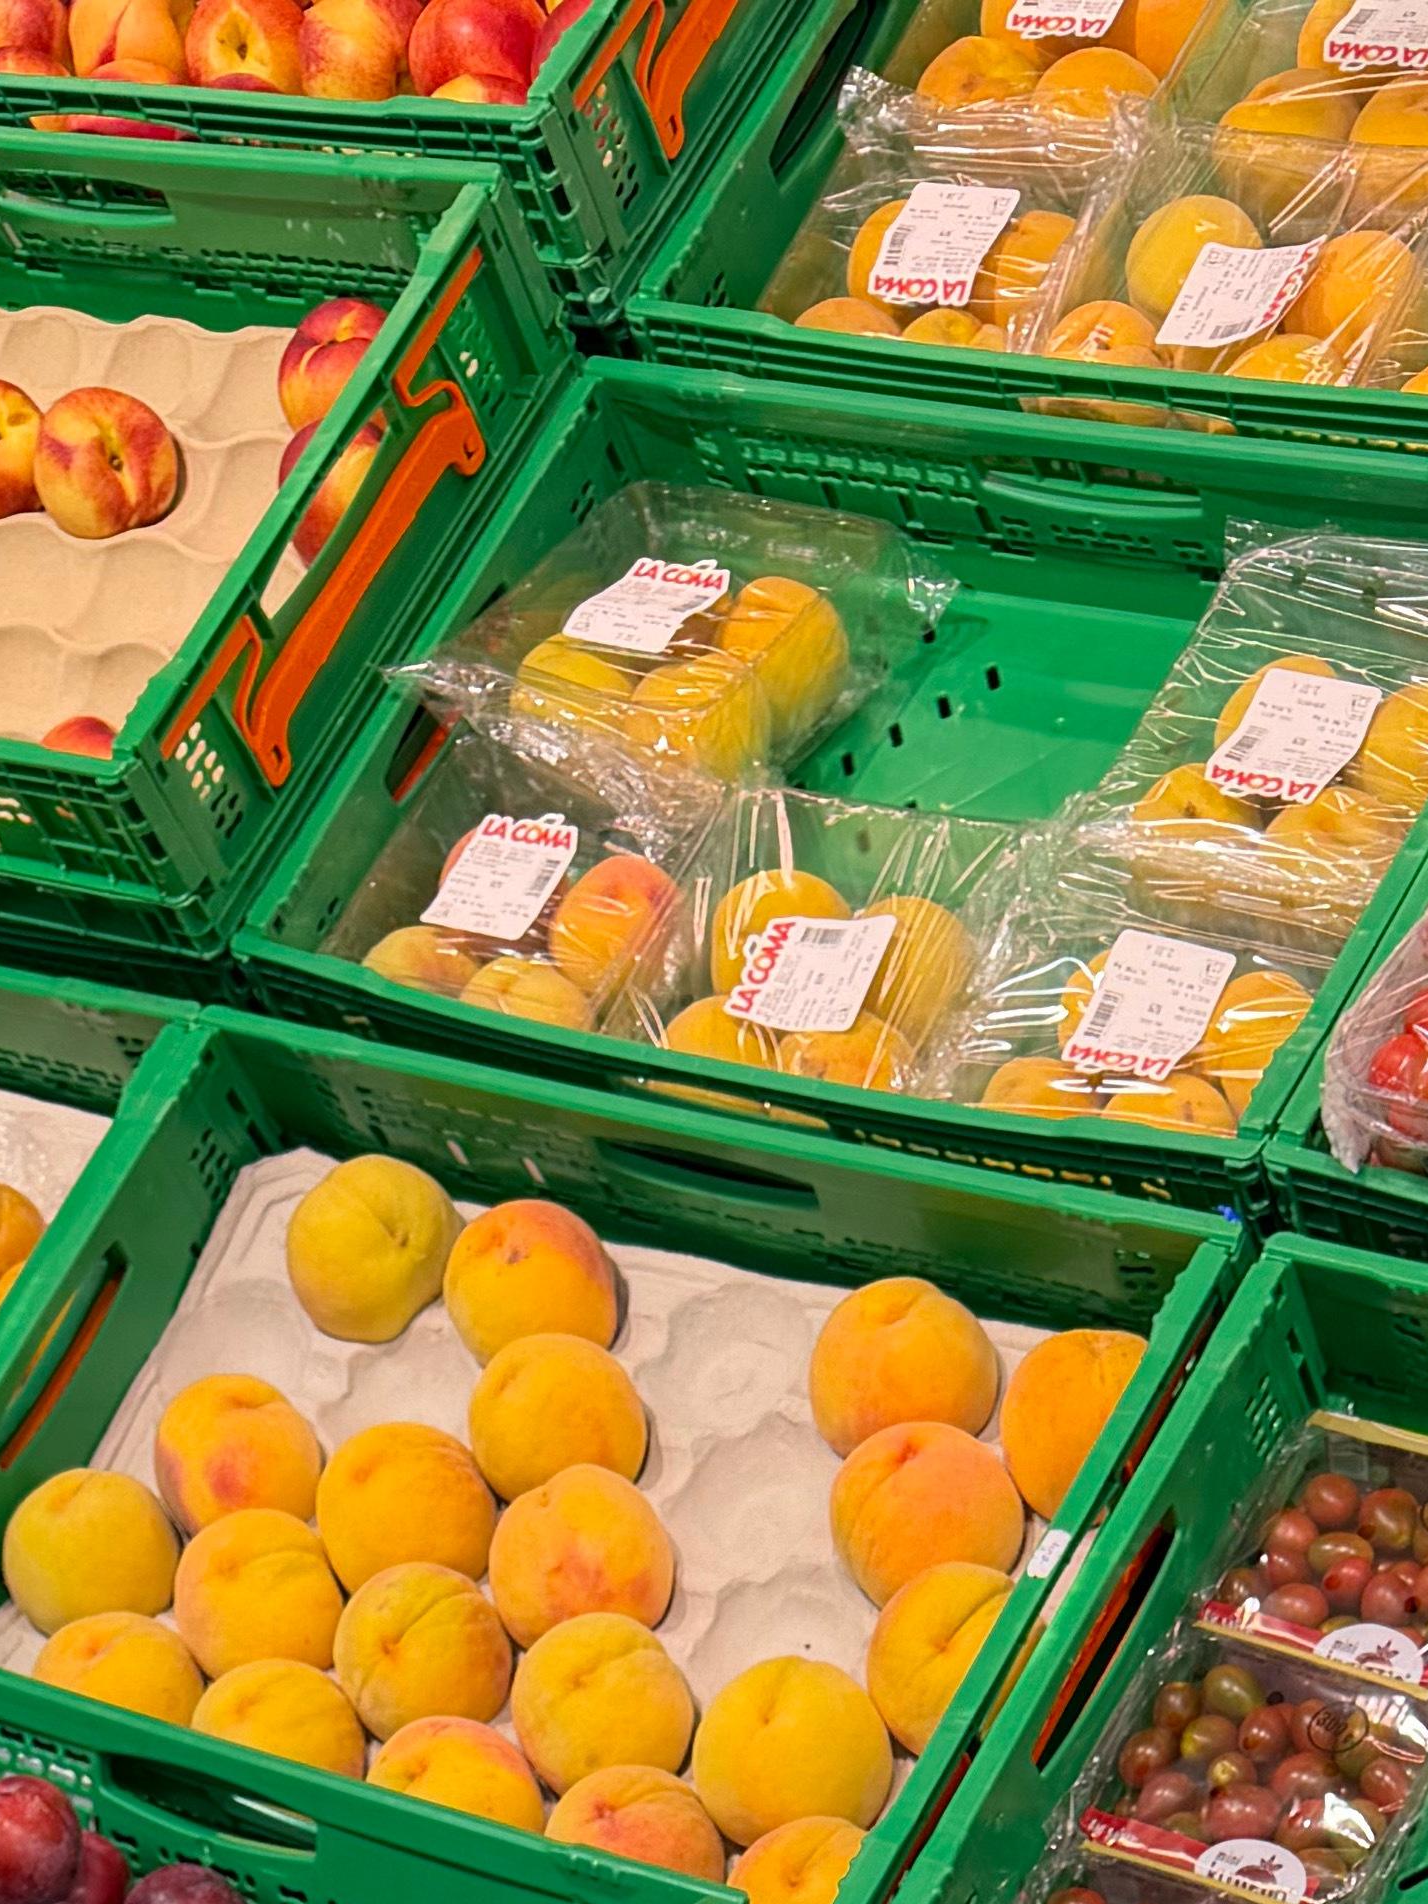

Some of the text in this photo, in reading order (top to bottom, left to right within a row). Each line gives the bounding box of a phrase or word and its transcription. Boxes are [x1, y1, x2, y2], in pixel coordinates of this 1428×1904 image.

[1327, 40, 1399, 64] COMA
[873, 273, 968, 303] LA COMA
[633, 561, 723, 591] LA COMA
[1210, 764, 1318, 800] LA COMA
[482, 819, 572, 851] LA COMA
[730, 920, 795, 1014] LA COMA
[1067, 1043, 1171, 1076] LA COMA
